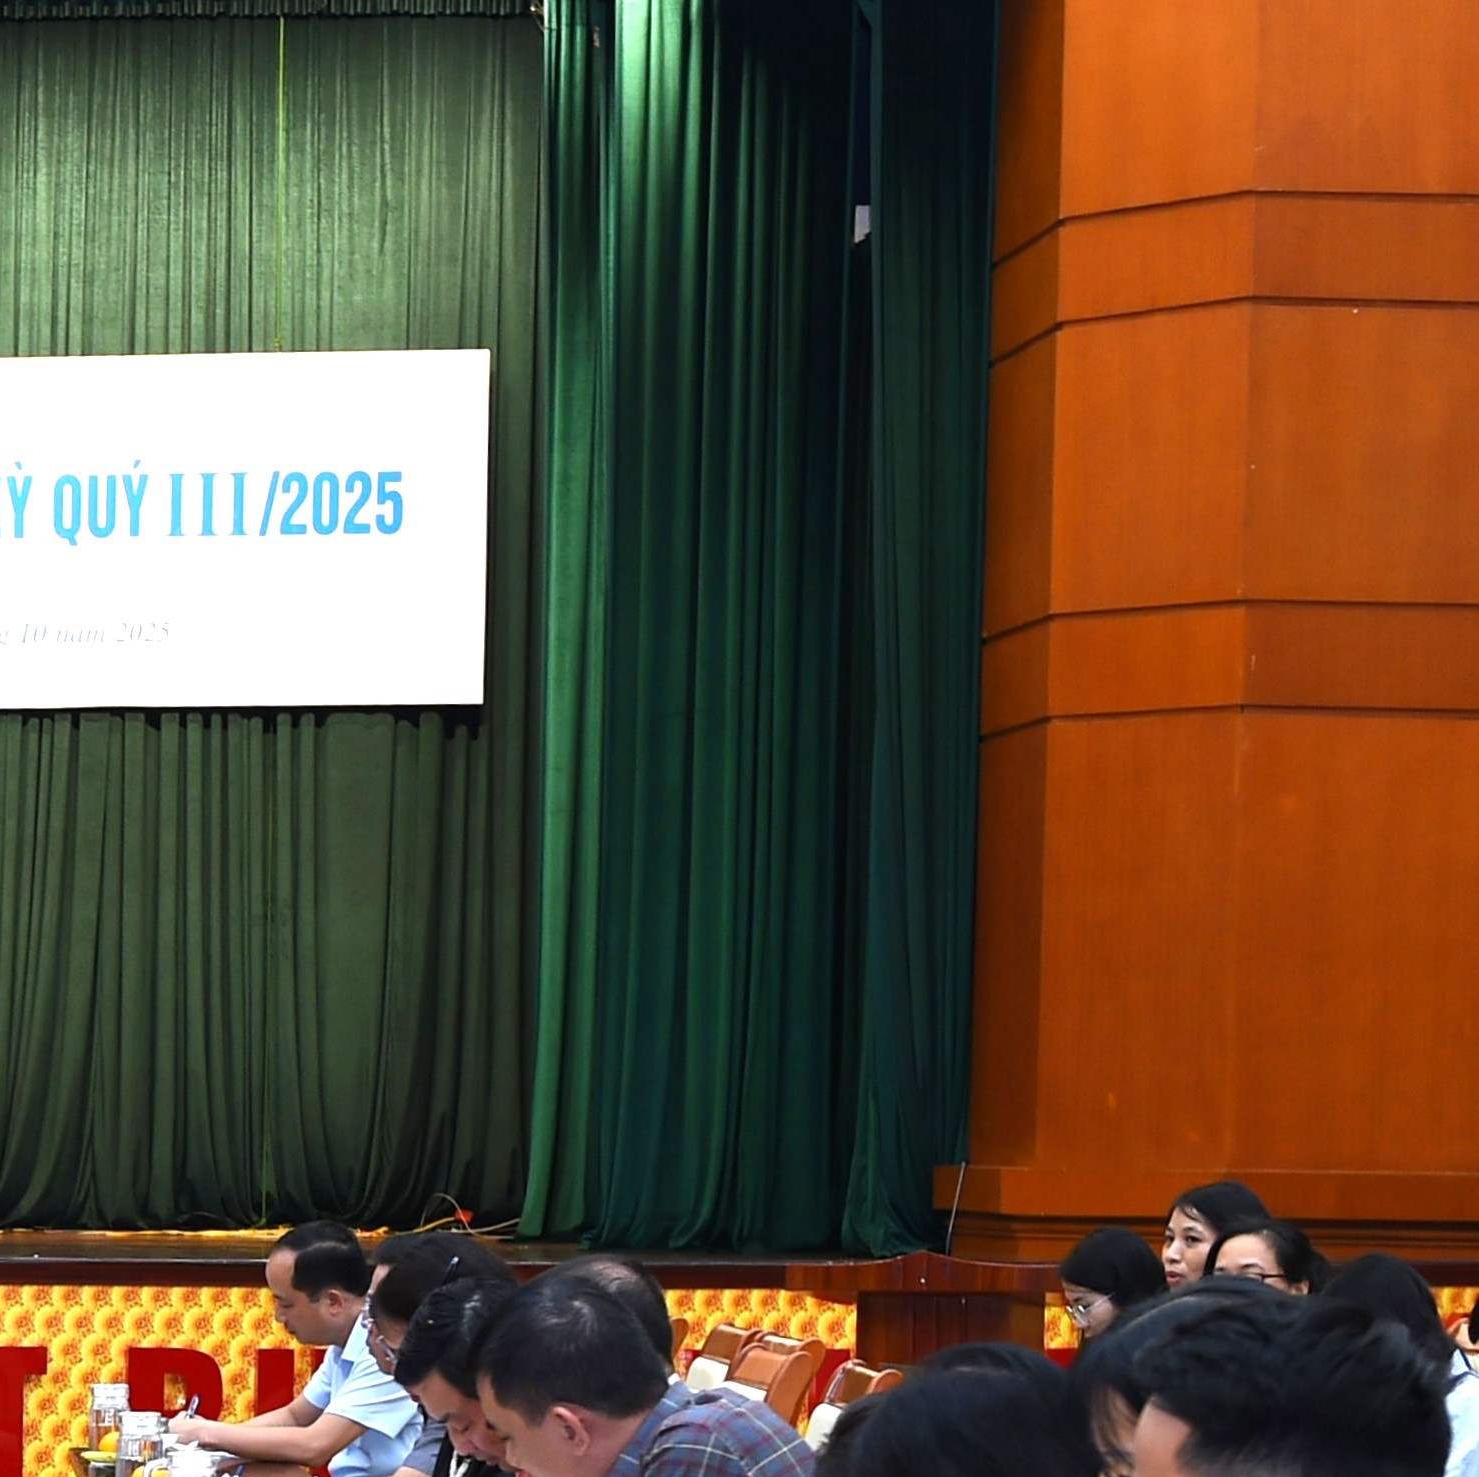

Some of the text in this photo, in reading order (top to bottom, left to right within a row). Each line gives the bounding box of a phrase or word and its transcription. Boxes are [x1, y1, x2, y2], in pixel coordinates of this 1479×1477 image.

[53, 459, 149, 546] QUÝ
[20, 623, 47, 644] 10
[116, 621, 170, 644] 2025
